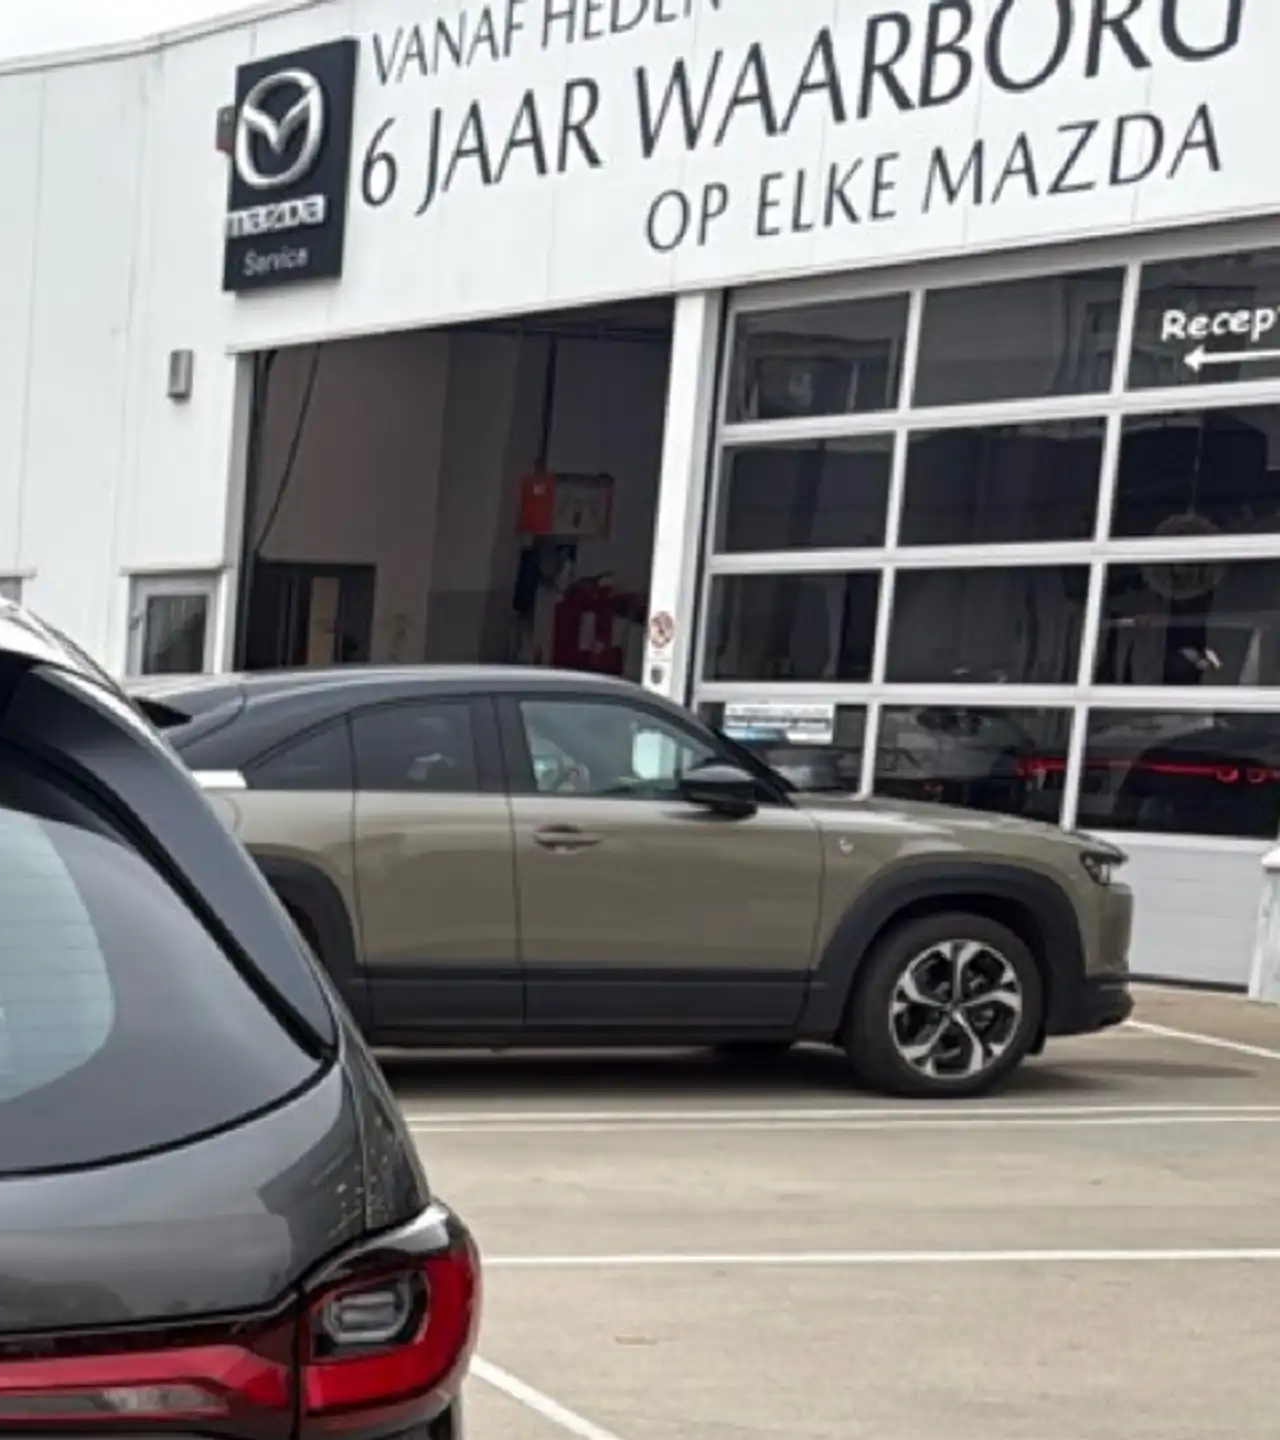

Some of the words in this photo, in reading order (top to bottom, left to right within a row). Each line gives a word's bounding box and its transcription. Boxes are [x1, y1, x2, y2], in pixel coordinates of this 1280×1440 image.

[373, 0, 524, 85] VANAF
[541, 0, 724, 50] HED
[361, 115, 398, 209] 6
[414, 77, 604, 216] JAAR
[645, 181, 730, 254] OP
[755, 151, 901, 238] ELKE
[921, 103, 1223, 214] MAZDA
[243, 246, 309, 277] Service
[1160, 305, 1280, 343] Recep
